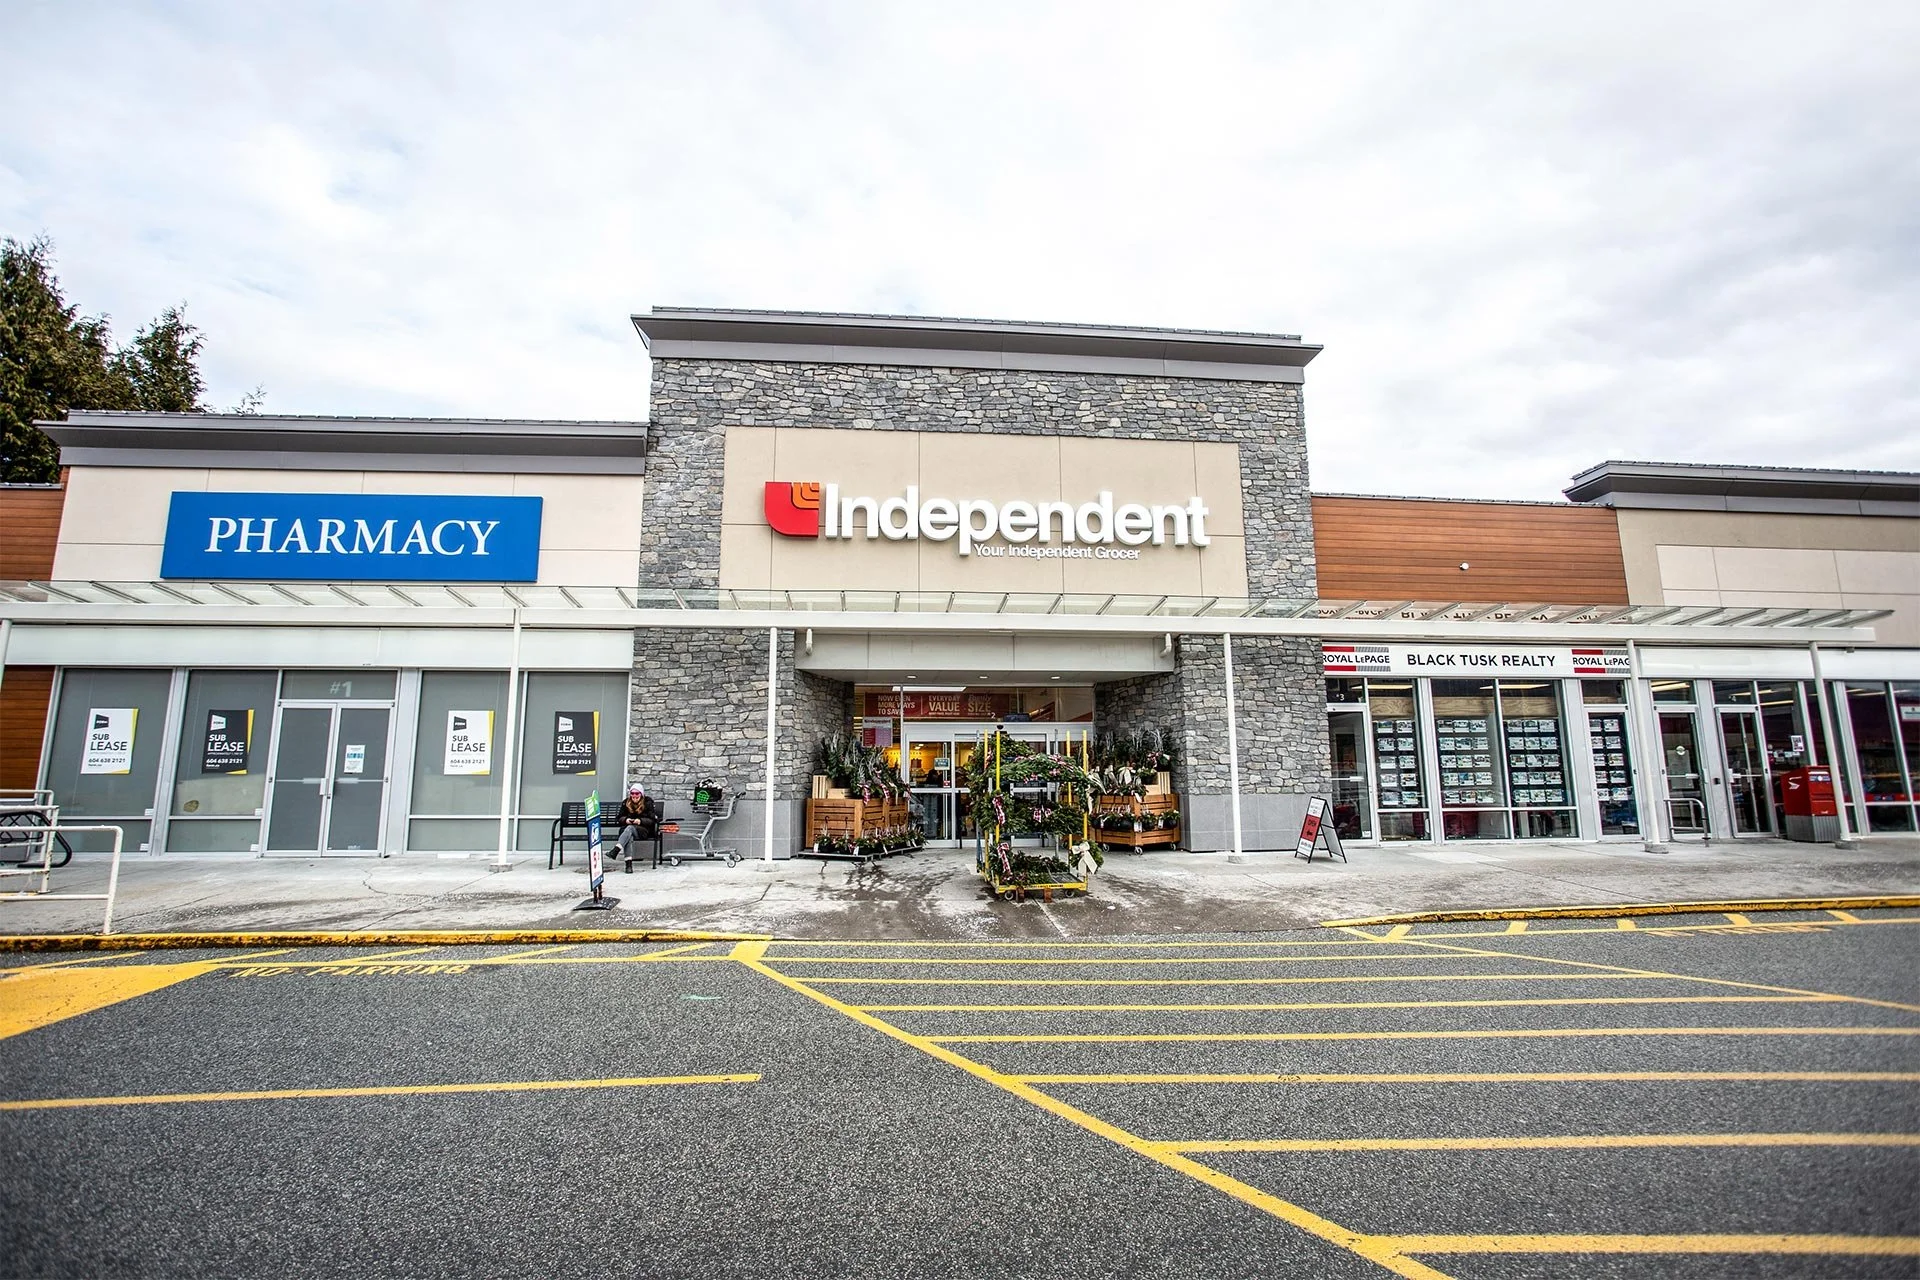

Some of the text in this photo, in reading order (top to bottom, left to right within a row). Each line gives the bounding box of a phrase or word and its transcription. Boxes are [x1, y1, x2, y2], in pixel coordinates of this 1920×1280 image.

[825, 483, 1211, 556] Independent
[204, 517, 500, 556] PHARMACY
[974, 543, 1140, 560] Your Independent Grocer
[1323, 654, 1353, 663] ROYAL
[1407, 654, 1555, 667] BLACK TUSK REALTY
[1572, 657, 1602, 665] ROYAL
[329, 681, 352, 698] #1
[929, 701, 960, 711] VALUE
[967, 701, 991, 712] SIZE
[92, 733, 110, 741] SUB
[209, 734, 227, 742] SUB
[557, 735, 574, 743] SUB
[90, 741, 128, 751] LEASE
[207, 741, 245, 752] LEASE
[451, 742, 486, 752] LEASE
[556, 743, 592, 753] LEASE
[228, 965, 471, 978] NO PARKING
